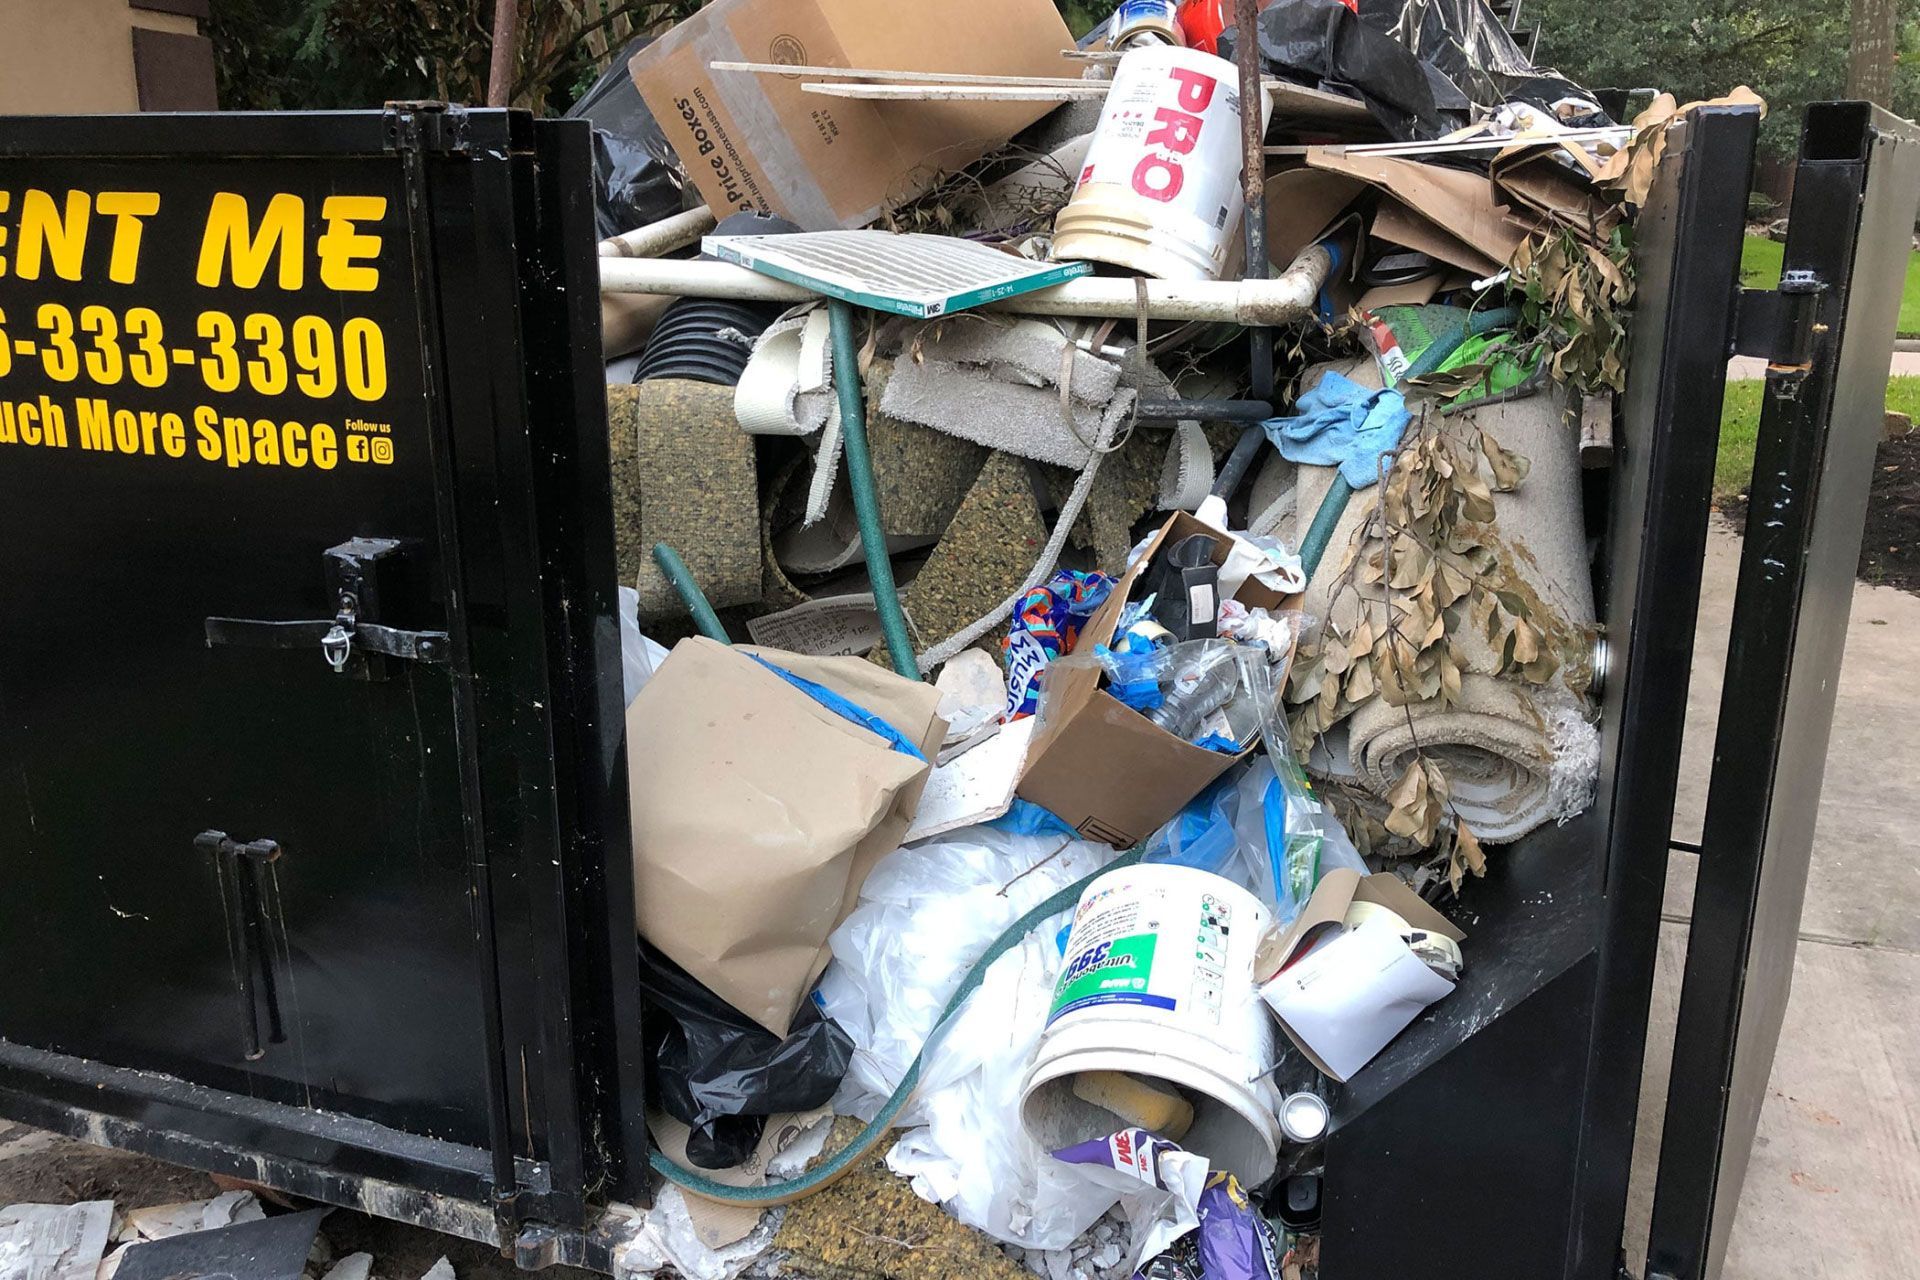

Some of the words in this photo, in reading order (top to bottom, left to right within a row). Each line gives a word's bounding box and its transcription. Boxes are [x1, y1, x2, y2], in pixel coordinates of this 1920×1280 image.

[1132, 67, 1217, 202] PRO
[710, 156, 743, 204] Price
[0, 189, 160, 284] NT
[196, 192, 387, 291] ME
[927, 303, 941, 315] 3M
[0, 303, 388, 402] -333-3390
[75, 398, 186, 458] More
[194, 405, 338, 469] Space
[345, 419, 377, 432] Follow
[379, 423, 391, 433] us
[1065, 941, 1112, 982] 399
[1115, 1130, 1133, 1166] 3M
